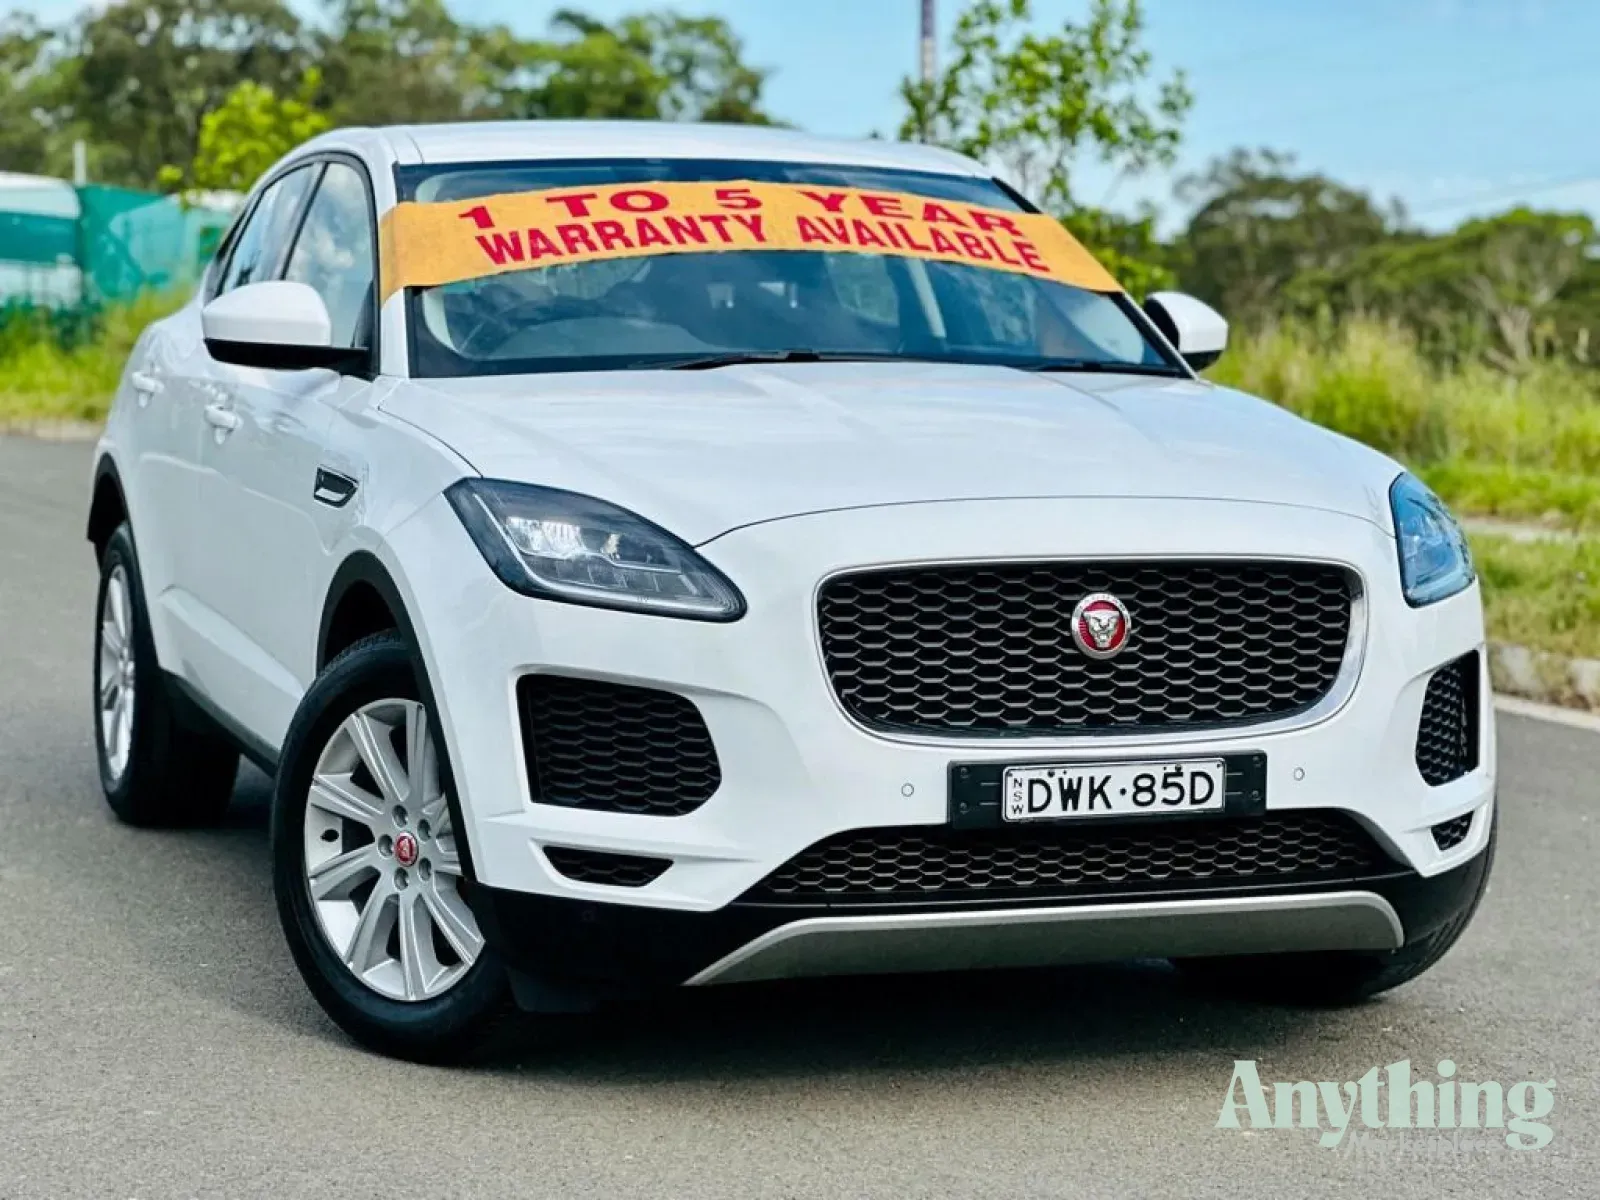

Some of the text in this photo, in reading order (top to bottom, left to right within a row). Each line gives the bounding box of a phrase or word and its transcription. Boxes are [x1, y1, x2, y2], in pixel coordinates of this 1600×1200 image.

[458, 188, 1025, 237] 1 TO 5 YEAR
[475, 214, 1051, 272] WARRANTY AVAILABLE
[1011, 777, 1025, 815] NSW
